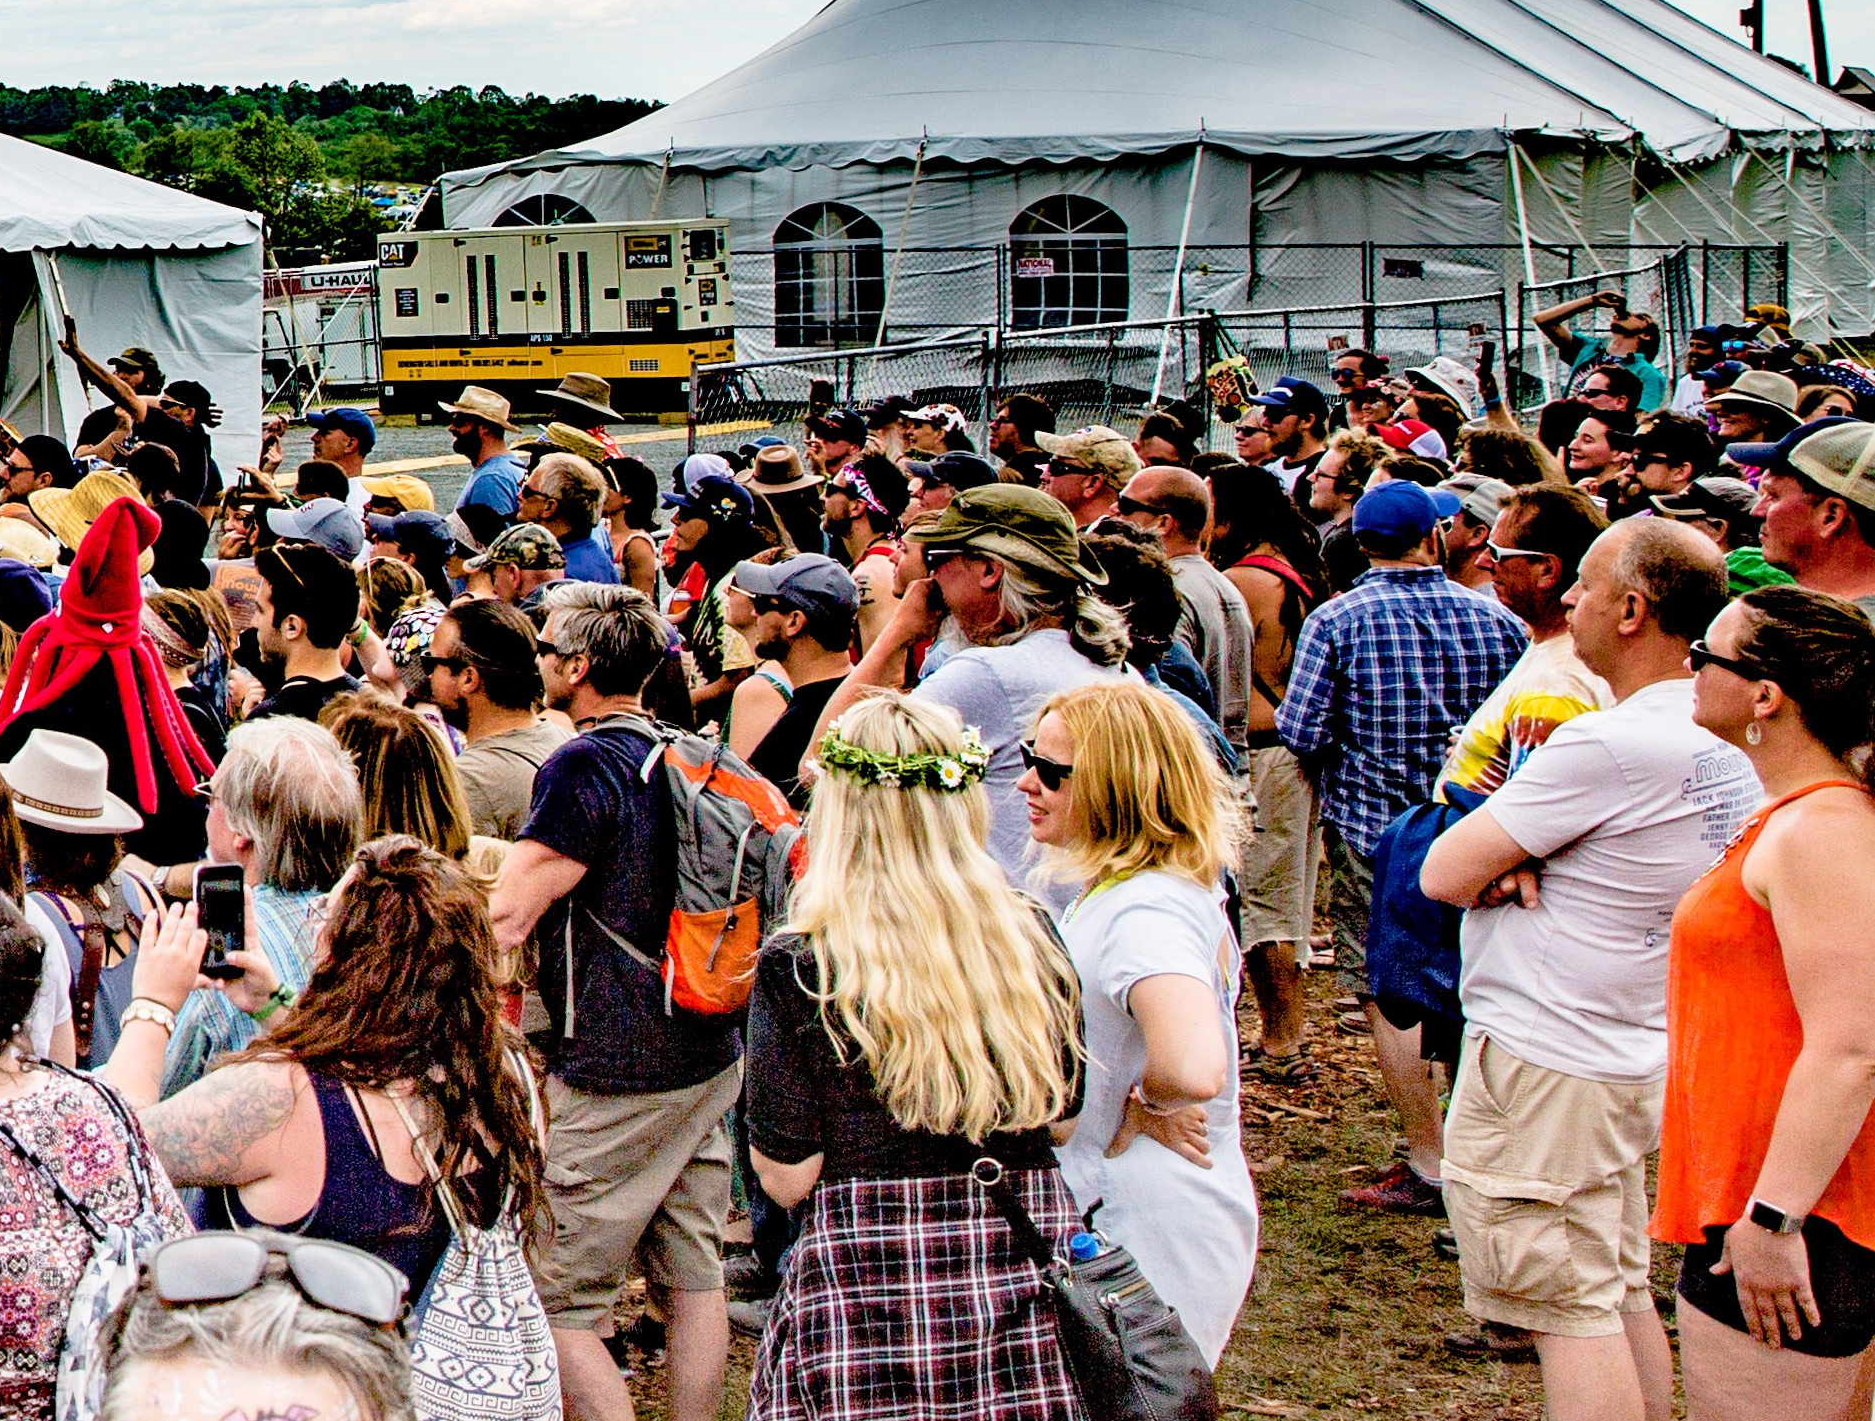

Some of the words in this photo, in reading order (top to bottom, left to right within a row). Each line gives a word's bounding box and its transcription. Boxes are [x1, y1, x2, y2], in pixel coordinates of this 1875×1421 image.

[380, 243, 405, 261] CAT
[310, 273, 371, 287] U-HAUL
[1702, 813, 1730, 823] FATHER
